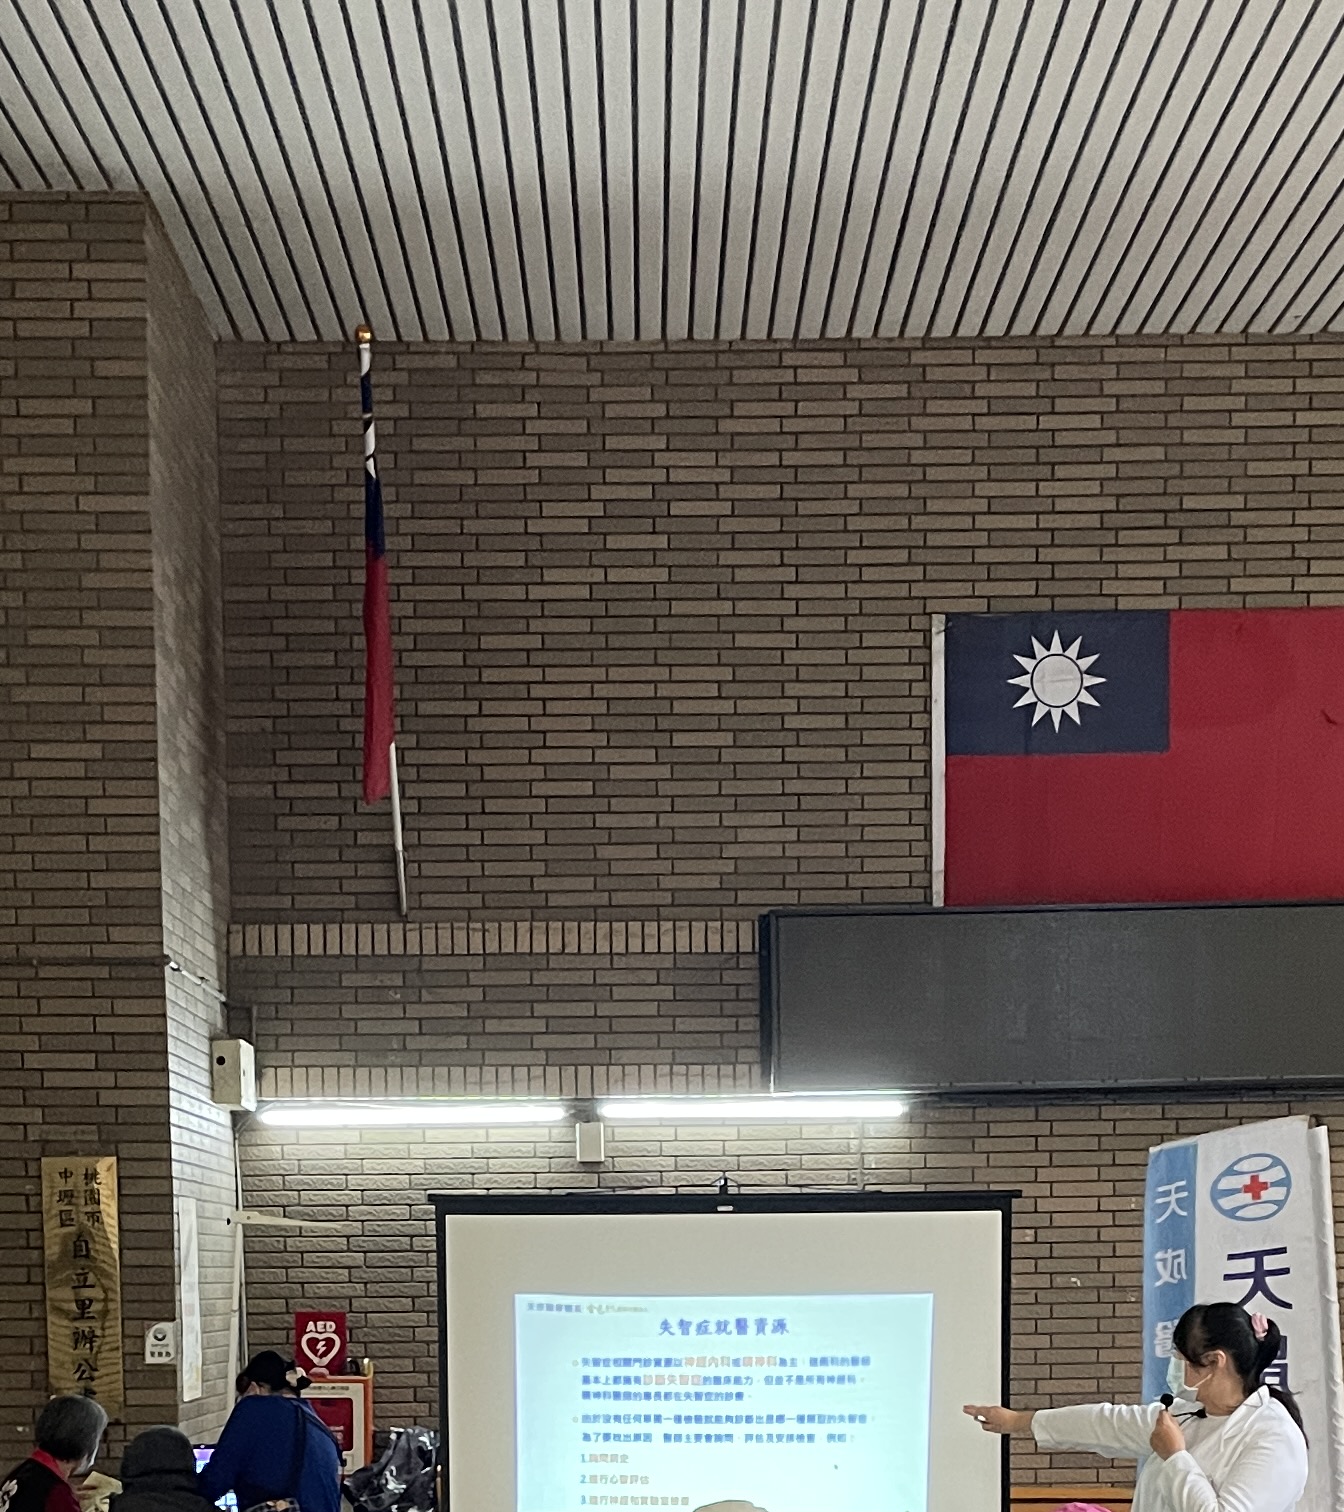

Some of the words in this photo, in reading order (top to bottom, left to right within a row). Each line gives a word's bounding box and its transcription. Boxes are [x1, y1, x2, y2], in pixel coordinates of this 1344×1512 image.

[57, 1167, 76, 1228] 中壢區
[84, 1167, 102, 1228] 桃園市
[306, 1321, 337, 1333] AED
[659, 1317, 791, 1337] 失智症就醫資源
